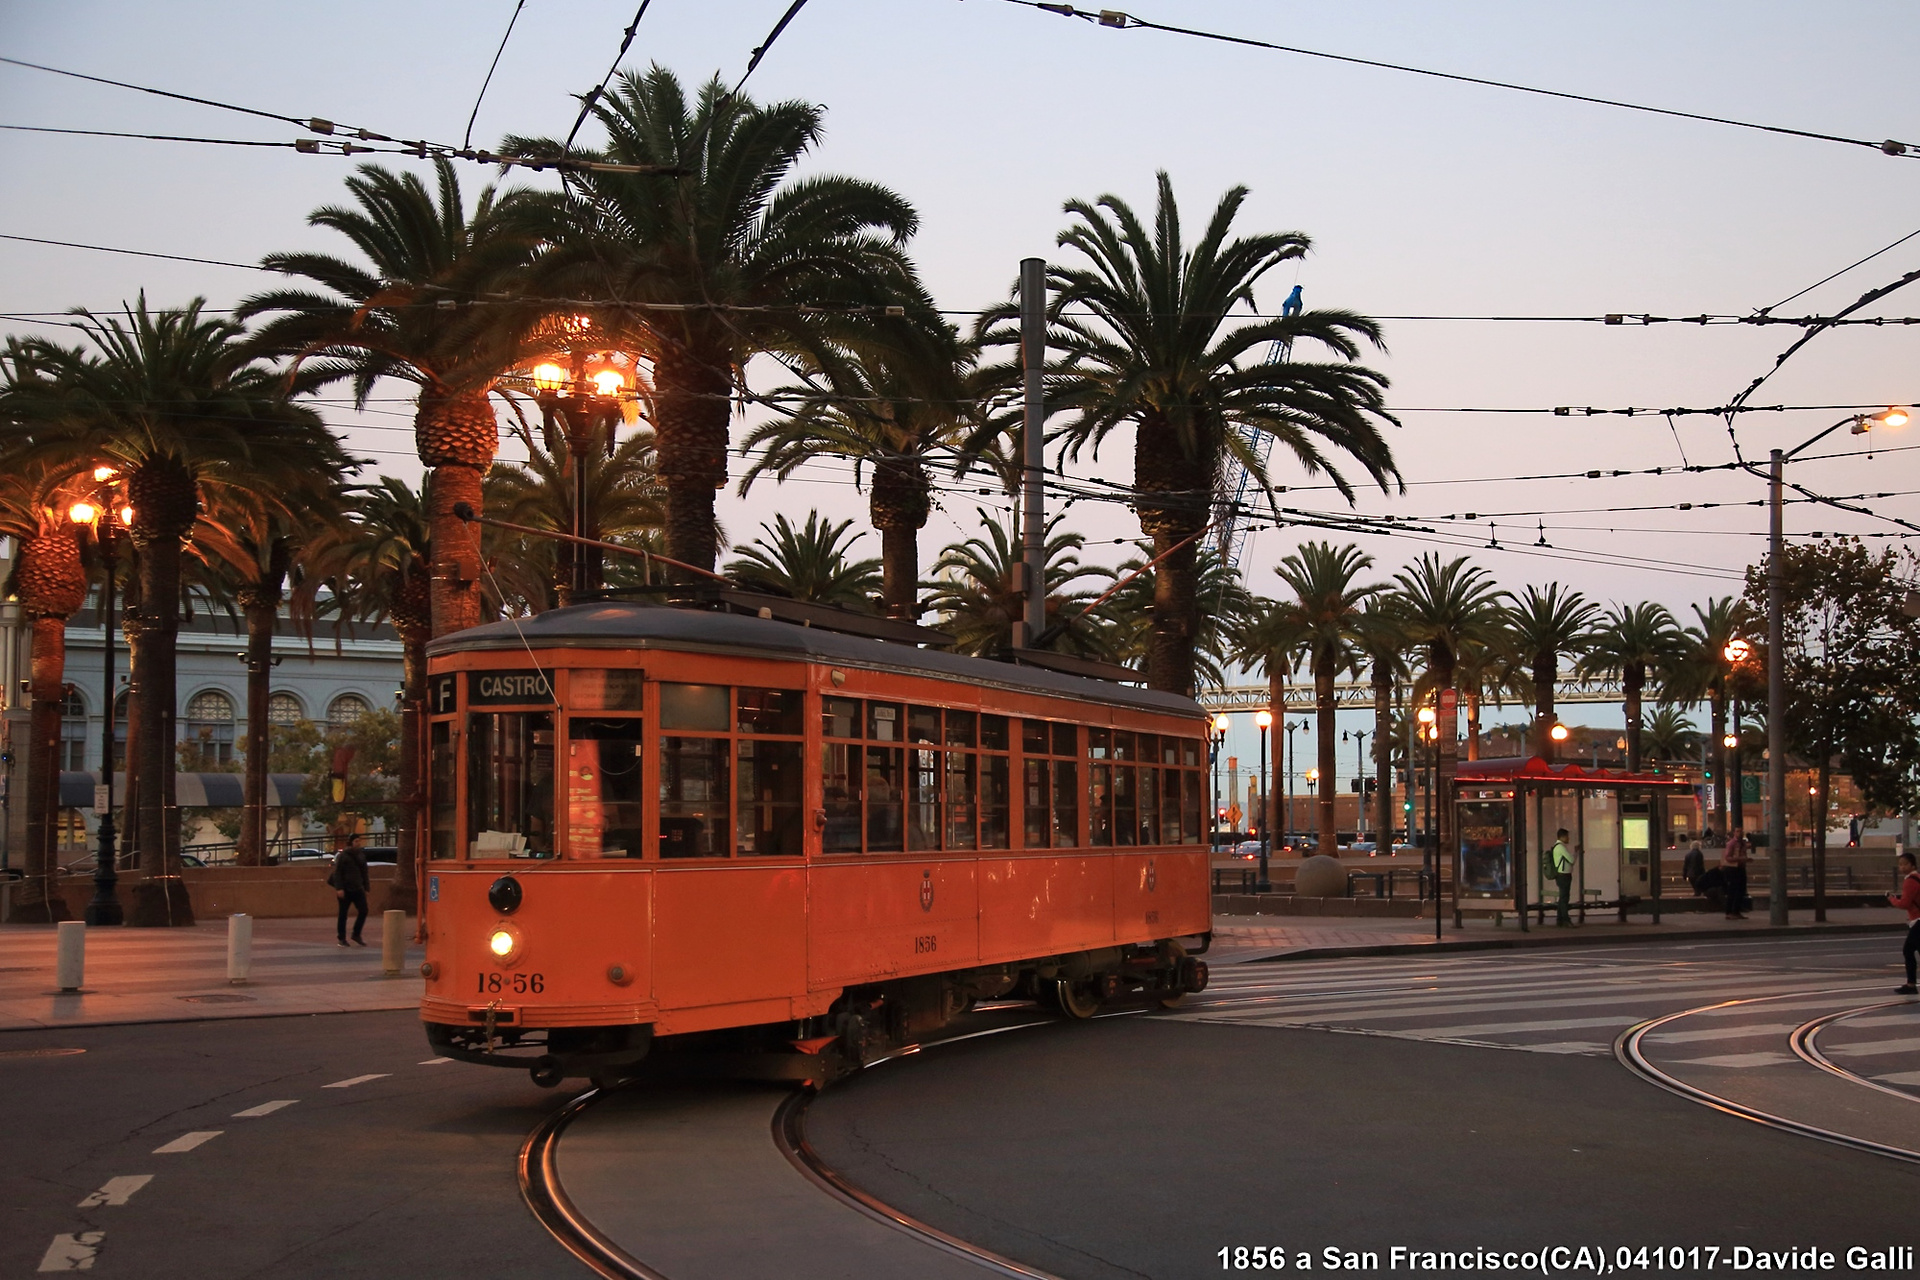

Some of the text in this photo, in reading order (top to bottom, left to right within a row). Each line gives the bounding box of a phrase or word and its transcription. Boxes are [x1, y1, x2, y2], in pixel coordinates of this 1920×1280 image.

[440, 679, 451, 712] F
[480, 676, 547, 697] CASTRO
[915, 935, 937, 954] 1856
[478, 972, 544, 994] 1856
